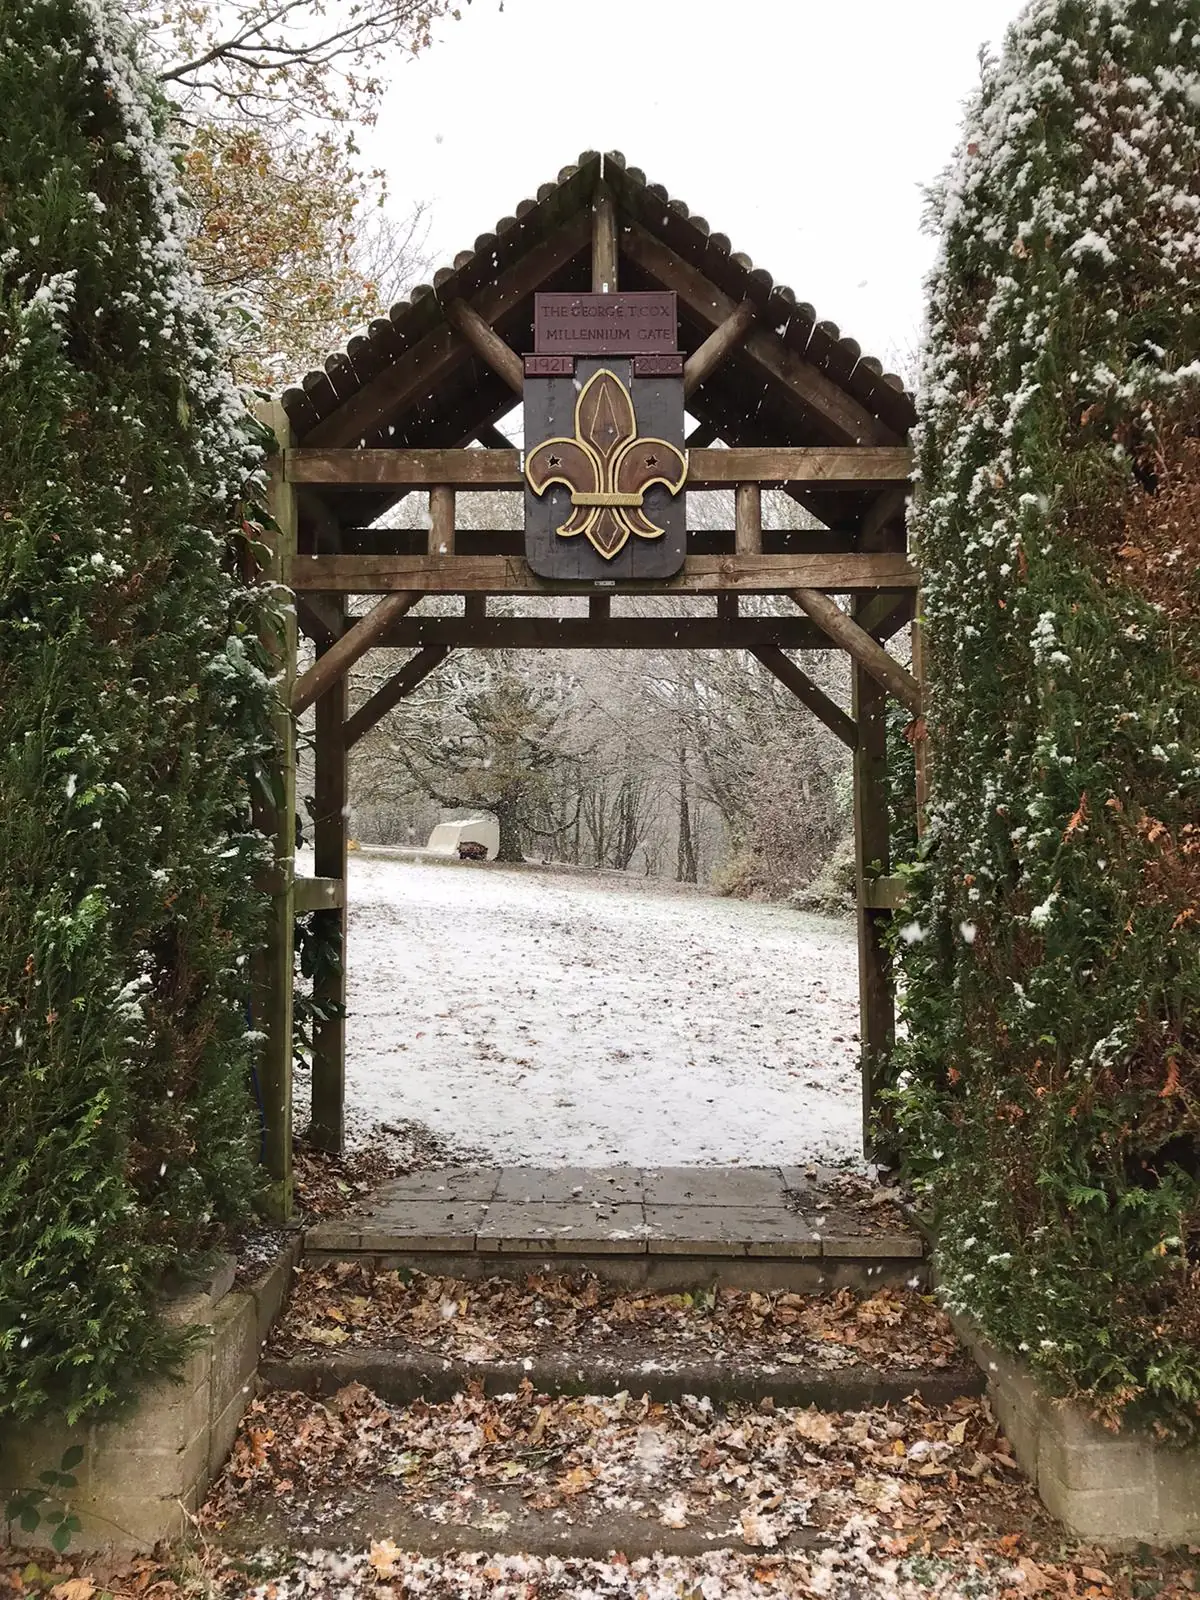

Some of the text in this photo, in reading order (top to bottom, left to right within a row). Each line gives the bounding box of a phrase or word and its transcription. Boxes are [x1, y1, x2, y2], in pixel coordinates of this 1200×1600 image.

[541, 306, 568, 317] THE
[571, 305, 624, 317] GEORGE
[640, 305, 670, 317] COX
[546, 328, 671, 340] MILLENNIUM GATE
[532, 358, 566, 372] 1921
